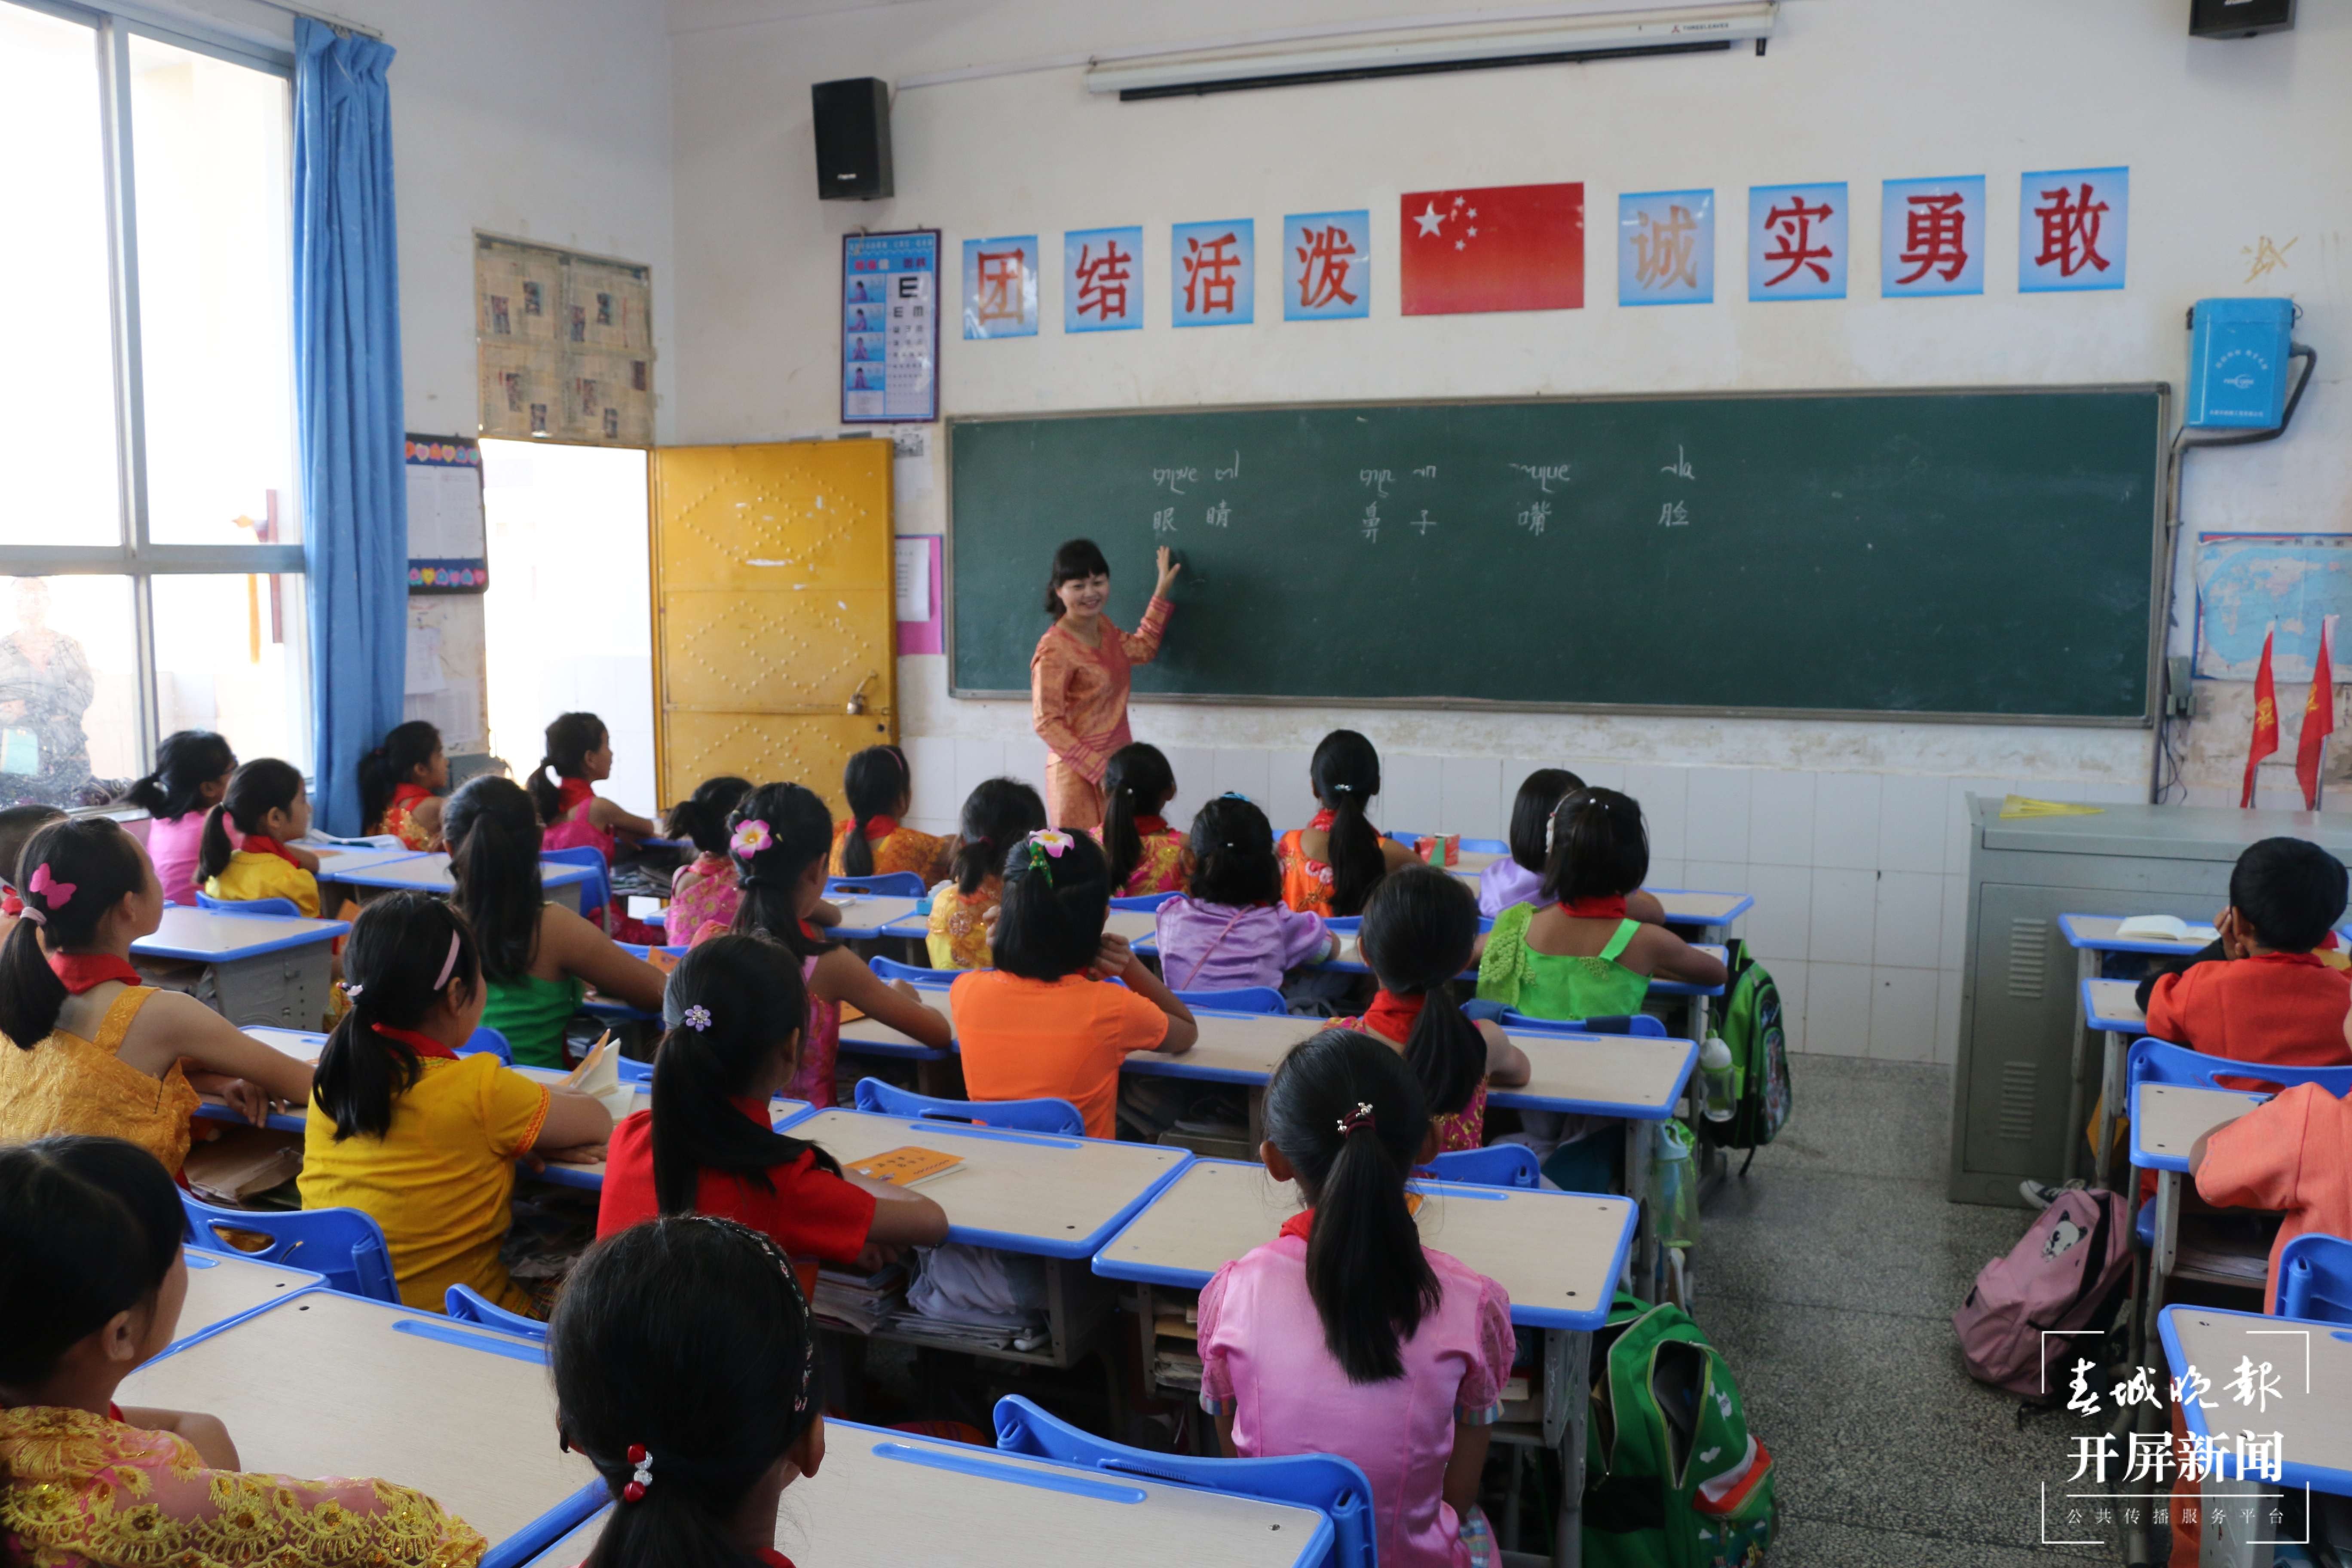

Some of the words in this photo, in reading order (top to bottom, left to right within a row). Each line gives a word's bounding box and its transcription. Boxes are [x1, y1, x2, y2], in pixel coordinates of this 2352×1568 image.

[977, 225, 1358, 325] 团结活泼
[1629, 183, 2110, 291] 诚实勇敢
[1518, 499, 1553, 536] 嘴
[1657, 500, 1690, 527] 脸
